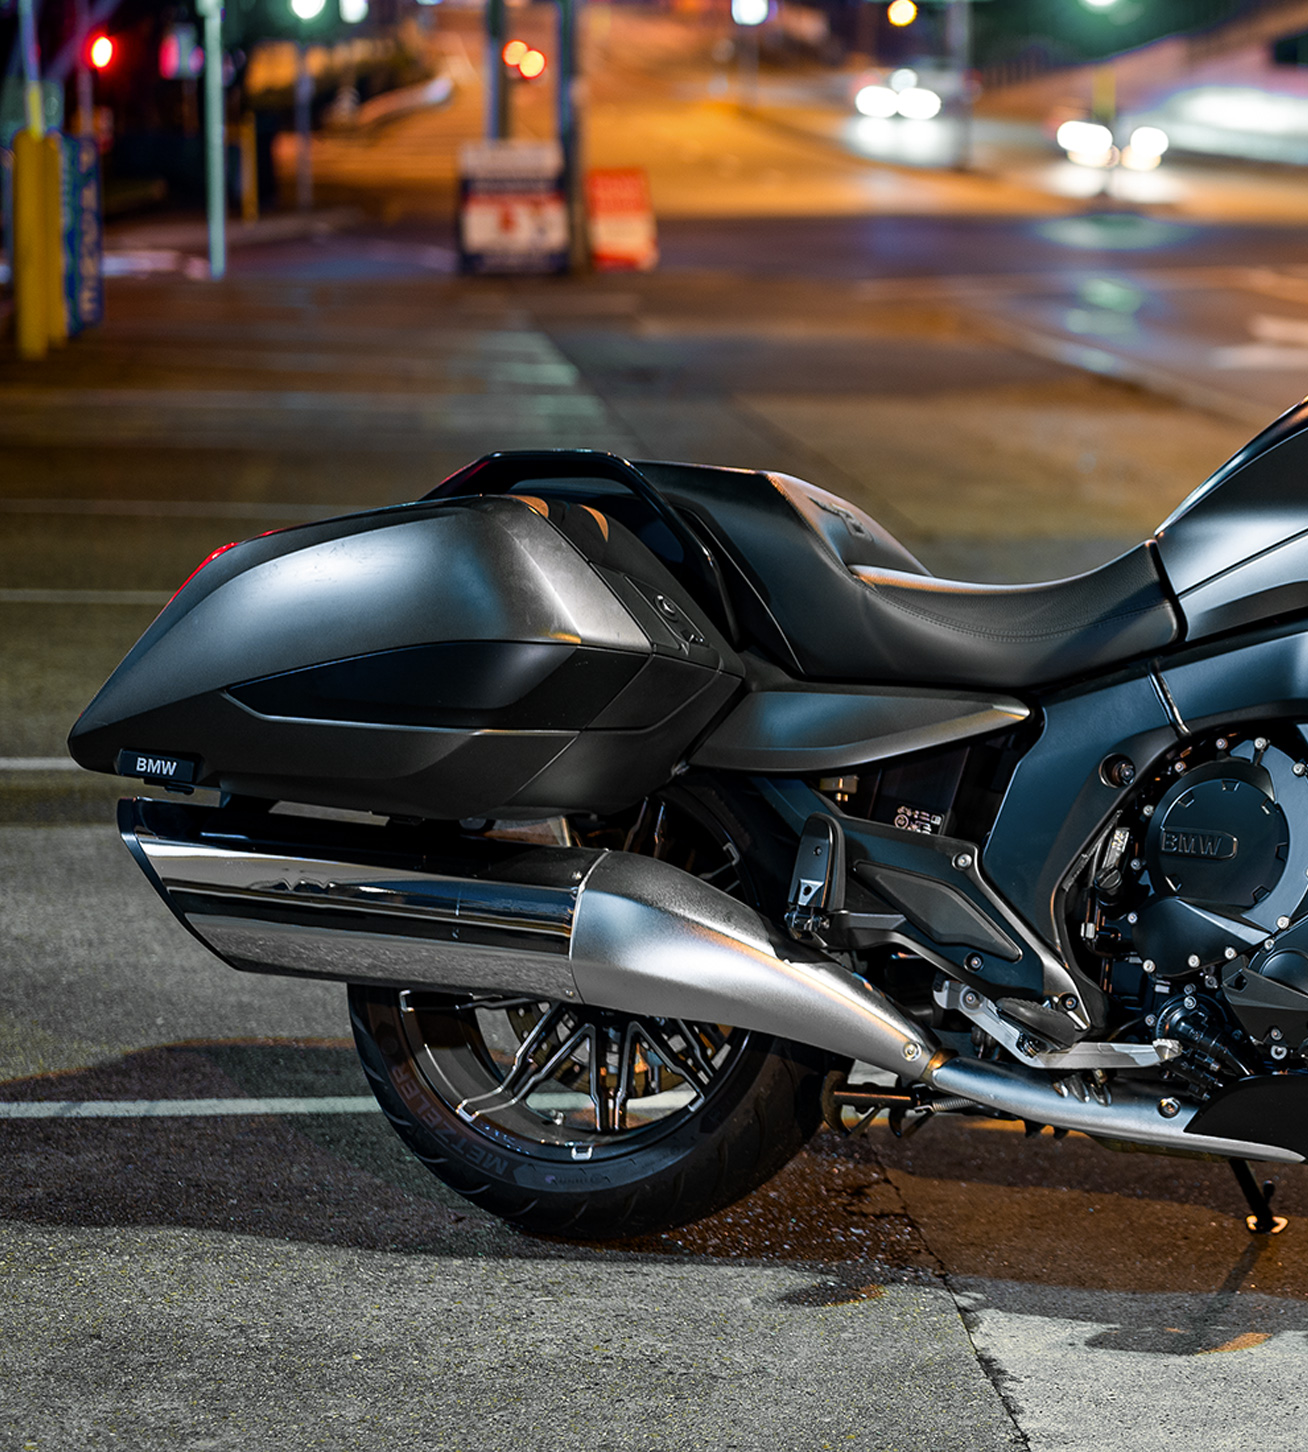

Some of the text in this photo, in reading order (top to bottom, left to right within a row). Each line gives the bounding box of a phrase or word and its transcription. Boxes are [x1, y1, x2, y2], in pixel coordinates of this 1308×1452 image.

[135, 756, 178, 776] BMW
[1160, 831, 1223, 856] BMW
[391, 1065, 510, 1177] METZELER
